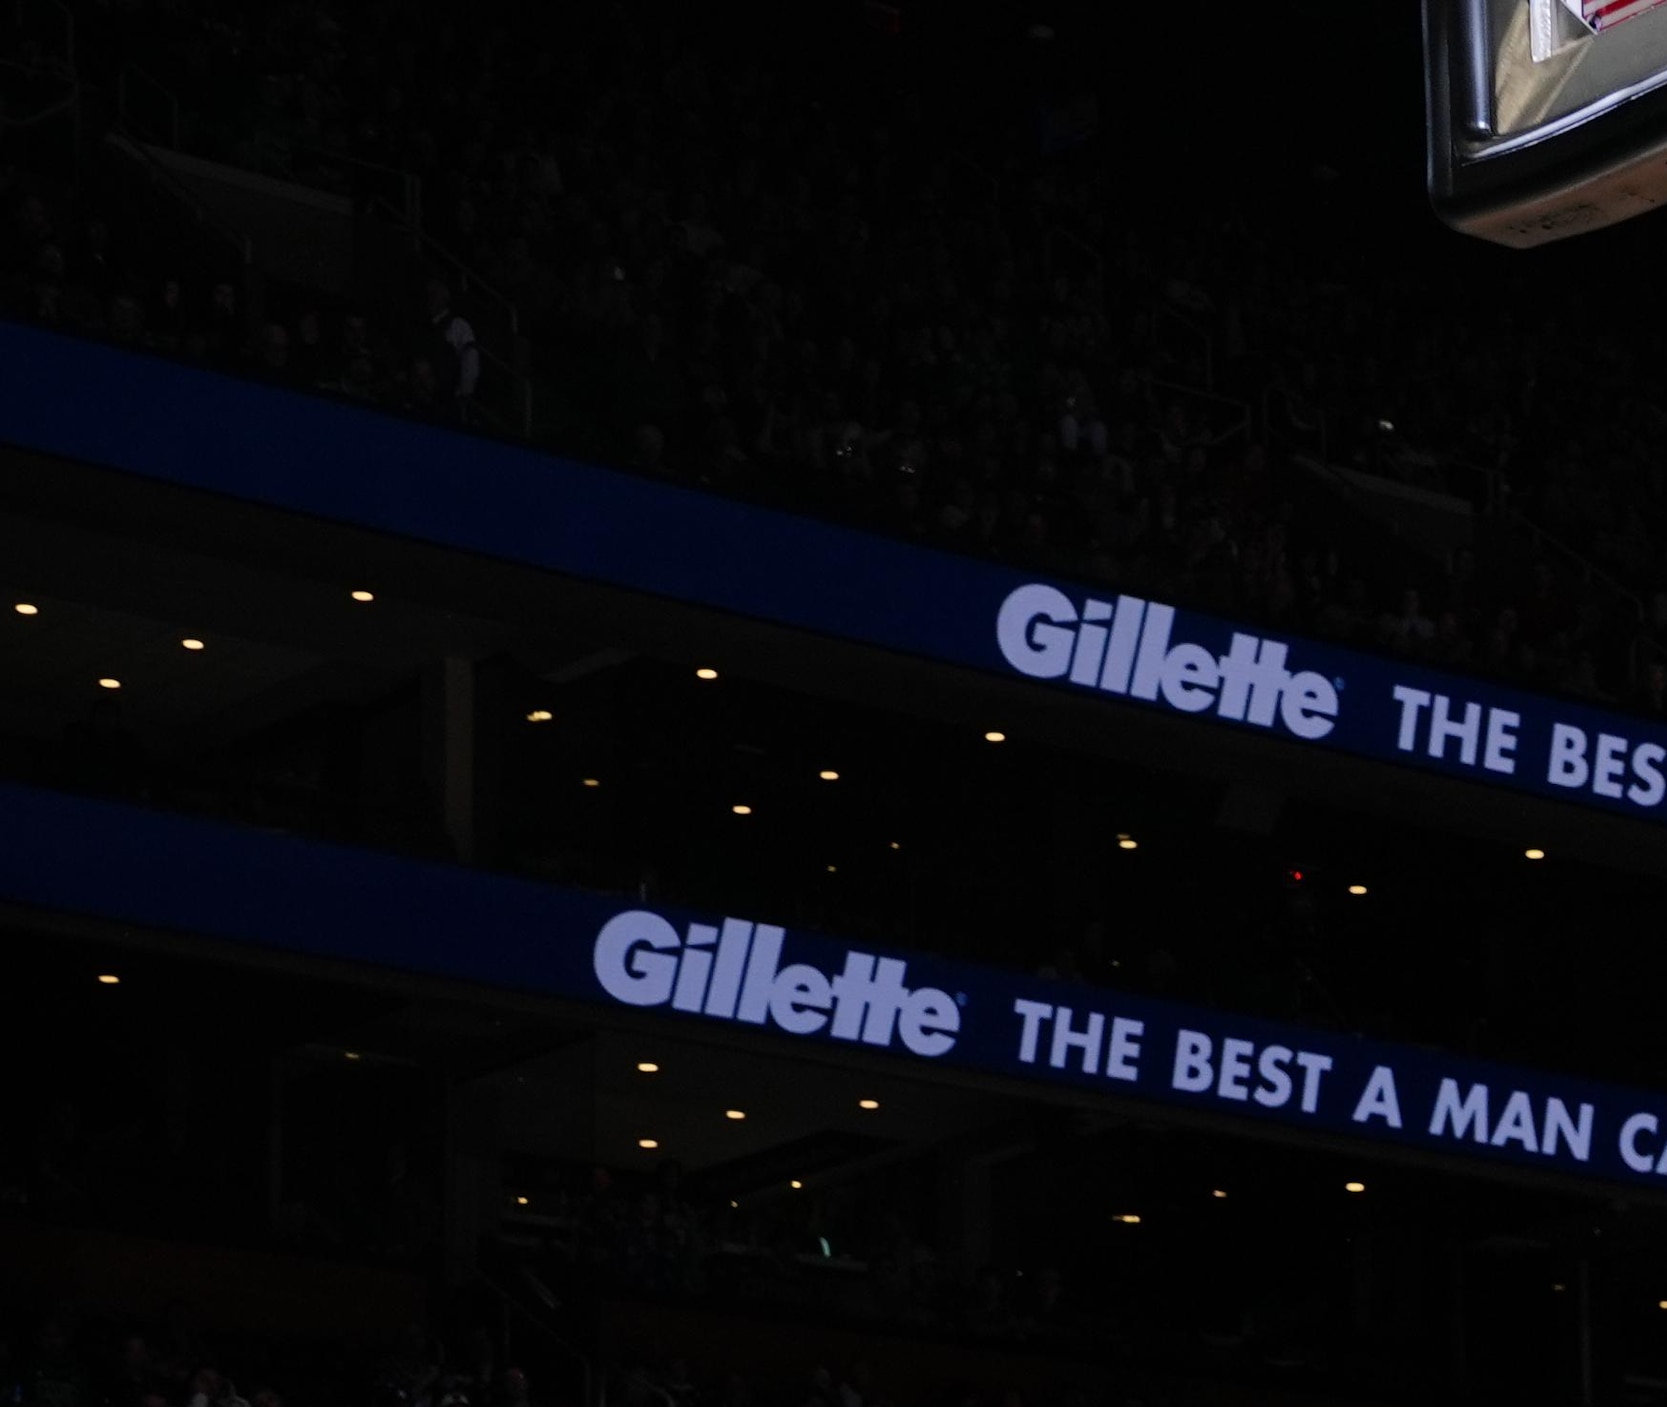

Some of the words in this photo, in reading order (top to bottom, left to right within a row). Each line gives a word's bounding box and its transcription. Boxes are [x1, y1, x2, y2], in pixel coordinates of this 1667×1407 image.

[997, 584, 1340, 739] Gillette
[1394, 685, 1520, 773] THE
[594, 912, 960, 1058] Gillette
[1015, 999, 1144, 1081] THE
[1173, 1029, 1332, 1113] BEST
[1353, 1066, 1401, 1127] A
[1429, 1078, 1594, 1160] MAN
